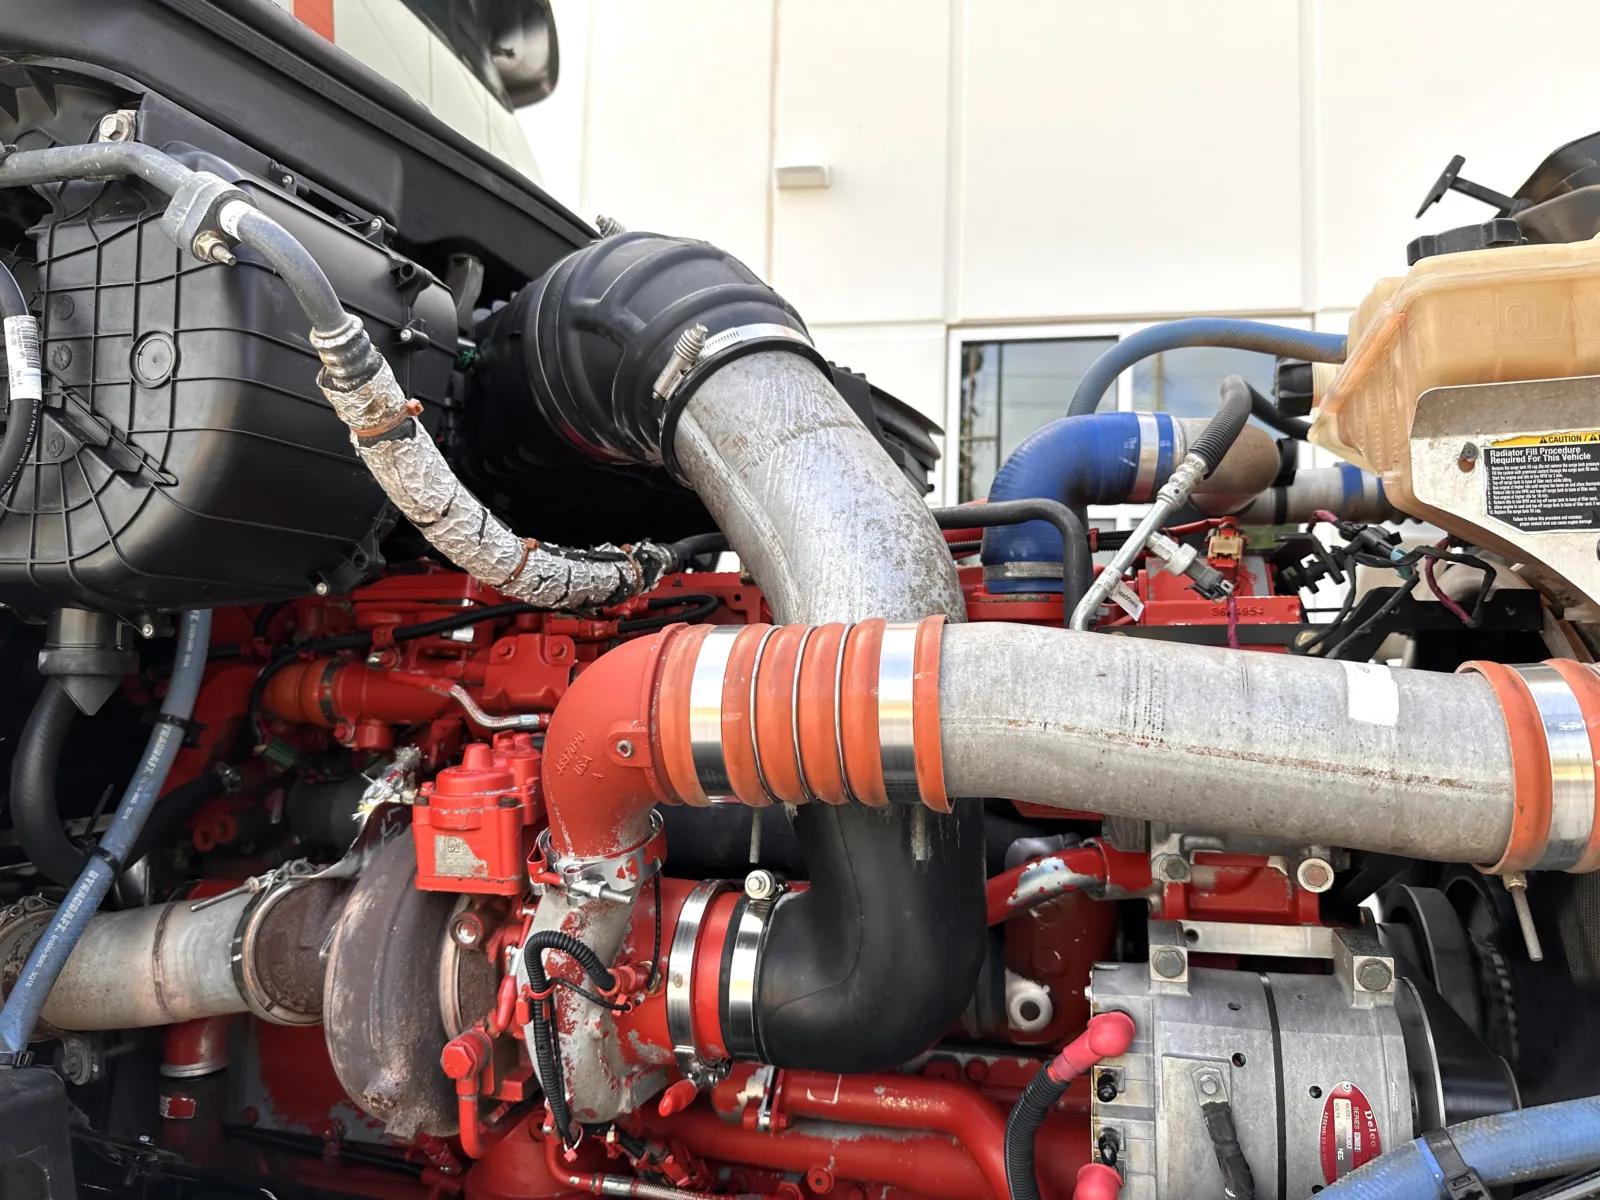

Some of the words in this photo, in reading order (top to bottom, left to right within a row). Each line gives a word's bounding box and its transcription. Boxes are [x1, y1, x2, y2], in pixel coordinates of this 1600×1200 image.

[1548, 435, 1582, 443] CAUTION
[1490, 449, 1523, 457] Radiator
[1525, 447, 1538, 456] Fill
[1540, 447, 1581, 455] Procedure
[1490, 455, 1526, 464] Required
[1543, 454, 1560, 462] This
[1561, 453, 1591, 461] Vehicle
[1211, 606, 1264, 616] 36954
[1364, 1110, 1377, 1148] Delco
